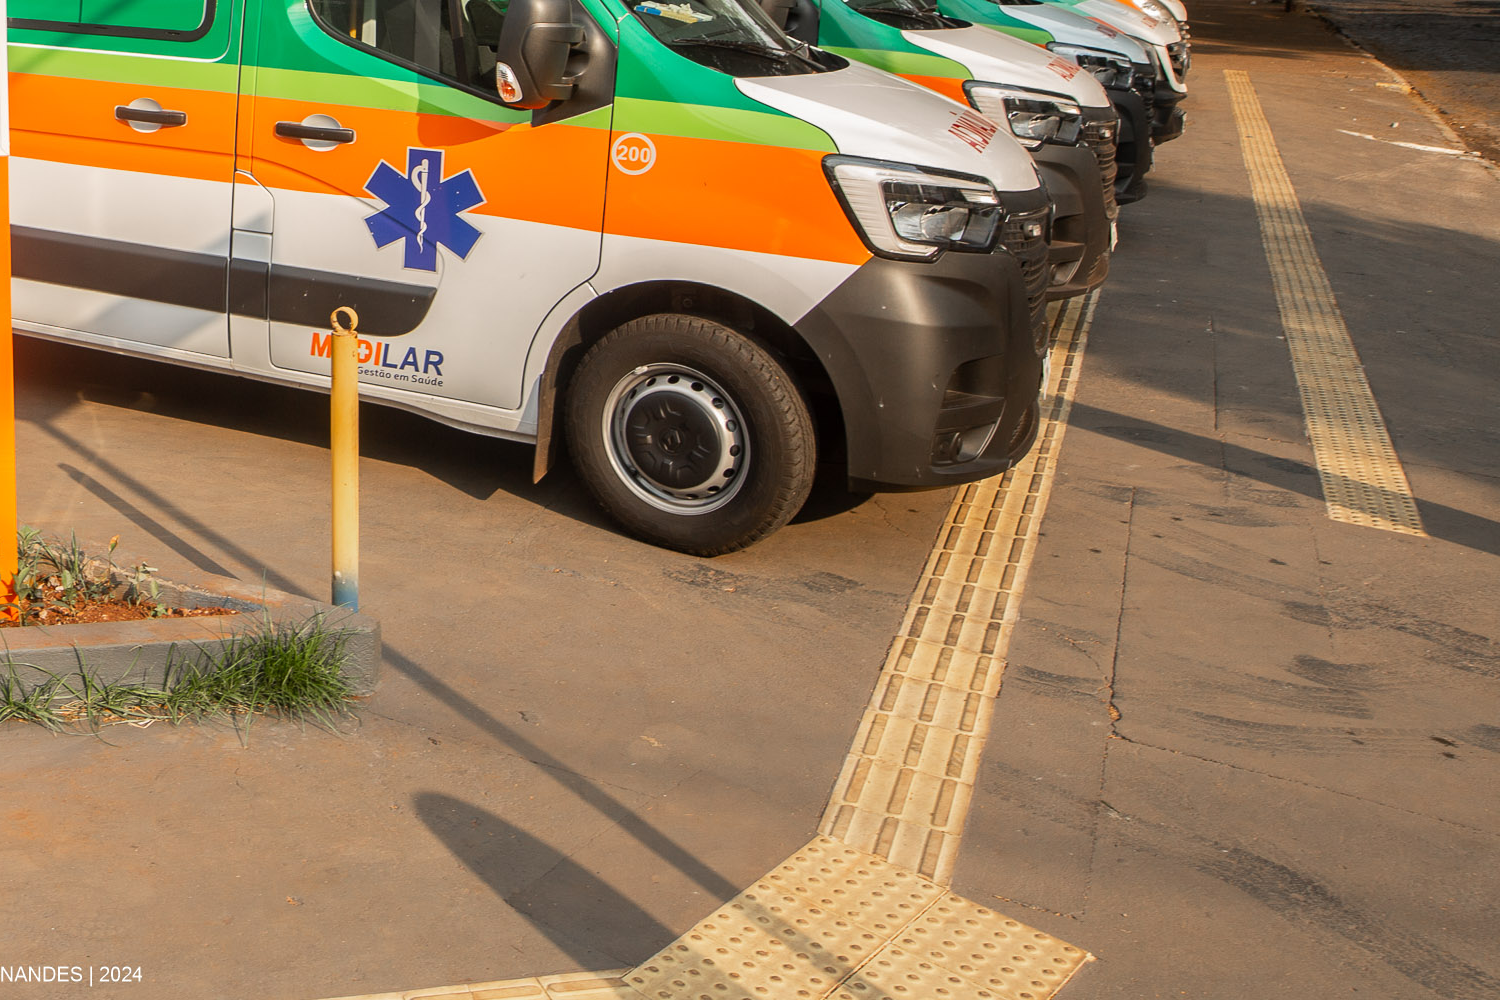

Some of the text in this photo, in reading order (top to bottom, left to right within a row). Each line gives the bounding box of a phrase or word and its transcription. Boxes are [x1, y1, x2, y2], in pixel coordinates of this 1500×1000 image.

[617, 145, 651, 163] 200
[310, 332, 444, 376] MDILAR
[394, 373, 409, 382] em
[411, 374, 444, 388] Saúde
